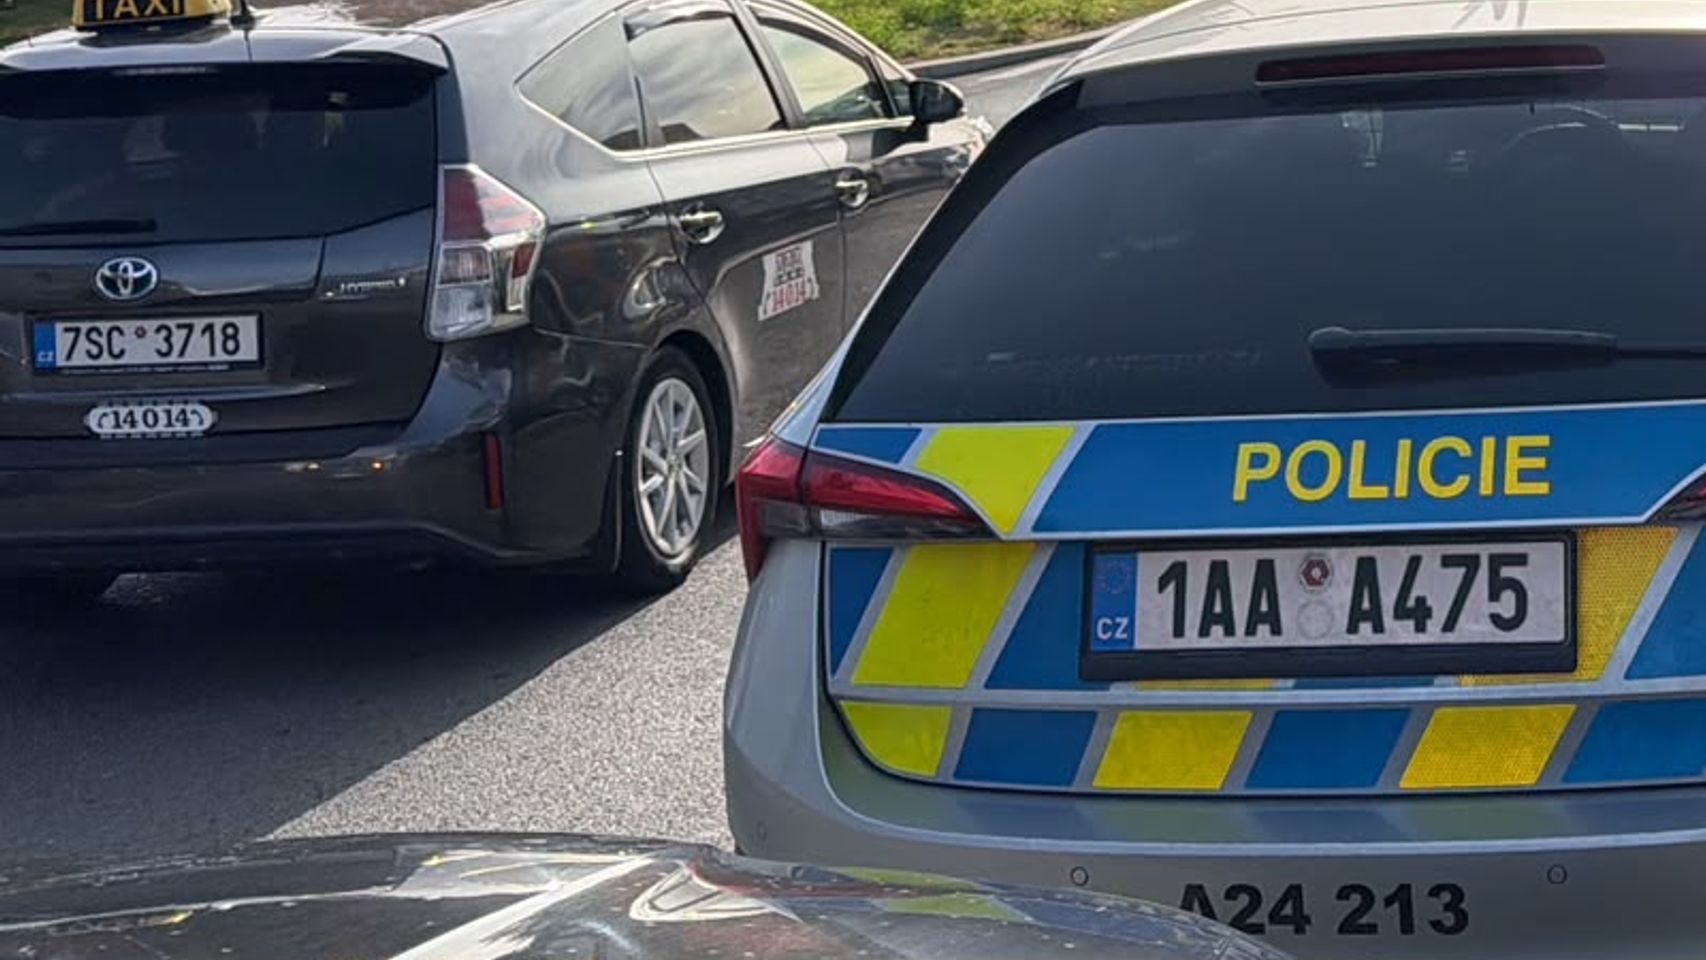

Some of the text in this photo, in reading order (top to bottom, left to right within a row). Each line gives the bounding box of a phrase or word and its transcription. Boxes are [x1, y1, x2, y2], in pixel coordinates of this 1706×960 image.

[38, 322, 241, 362] CZ 7SC 3718
[1232, 435, 1552, 502] POLICIE
[1096, 552, 1529, 640] CZ 1AA A475
[1179, 882, 1470, 935] A24 213
